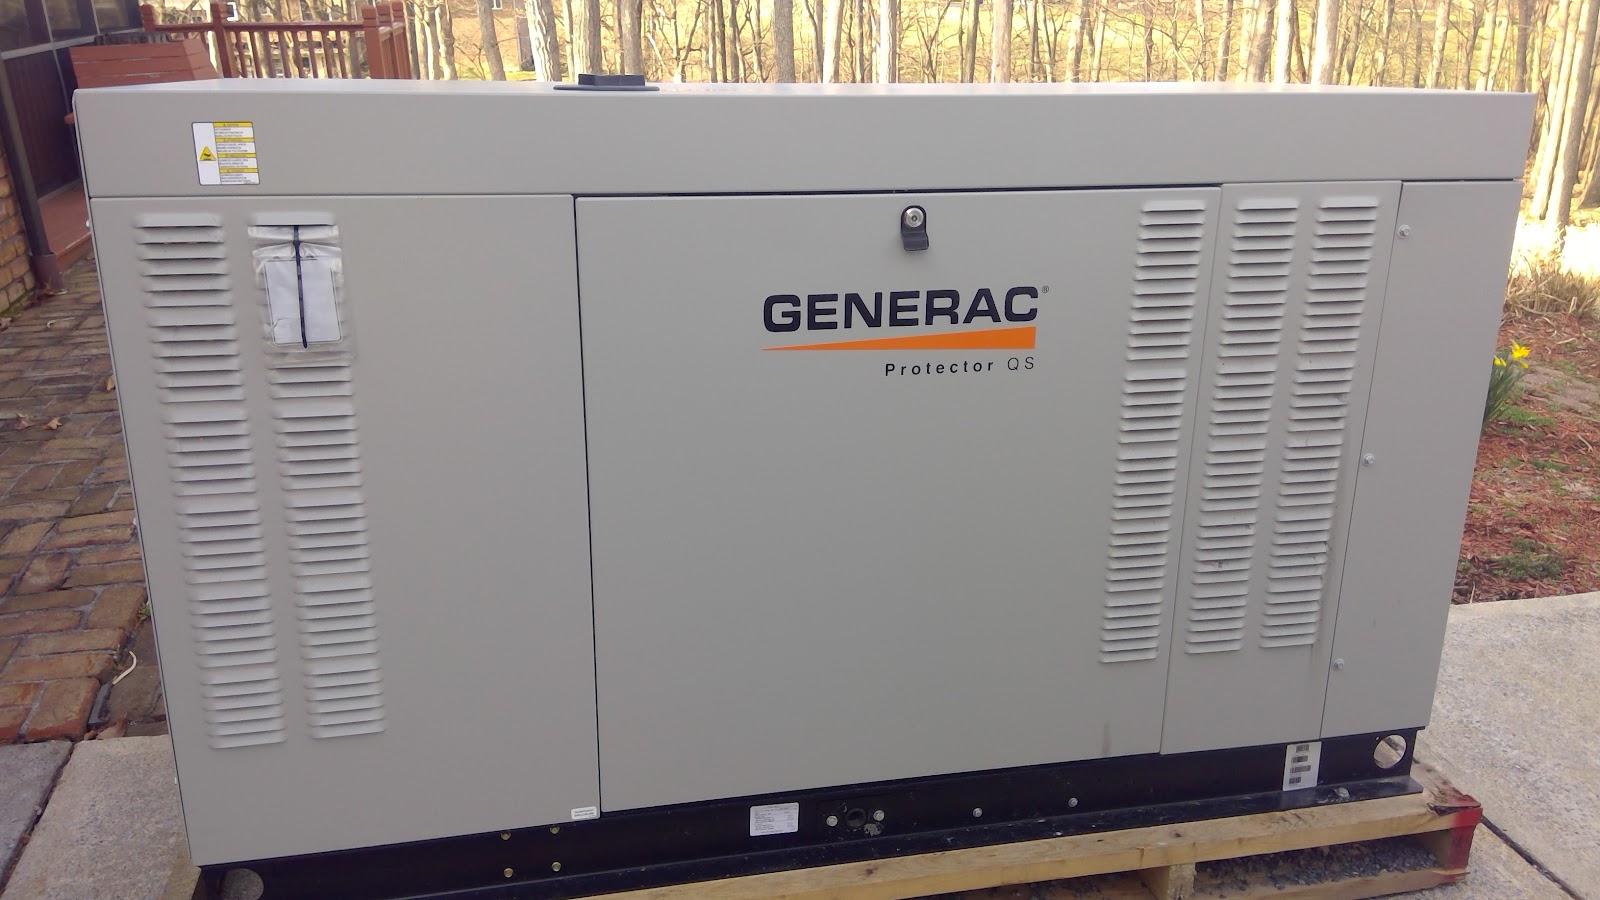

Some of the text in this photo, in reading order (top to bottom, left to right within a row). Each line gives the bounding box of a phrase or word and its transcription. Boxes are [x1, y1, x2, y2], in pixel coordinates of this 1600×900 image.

[763, 286, 1039, 332] GENERAC
[885, 356, 1034, 376] Protector QS
